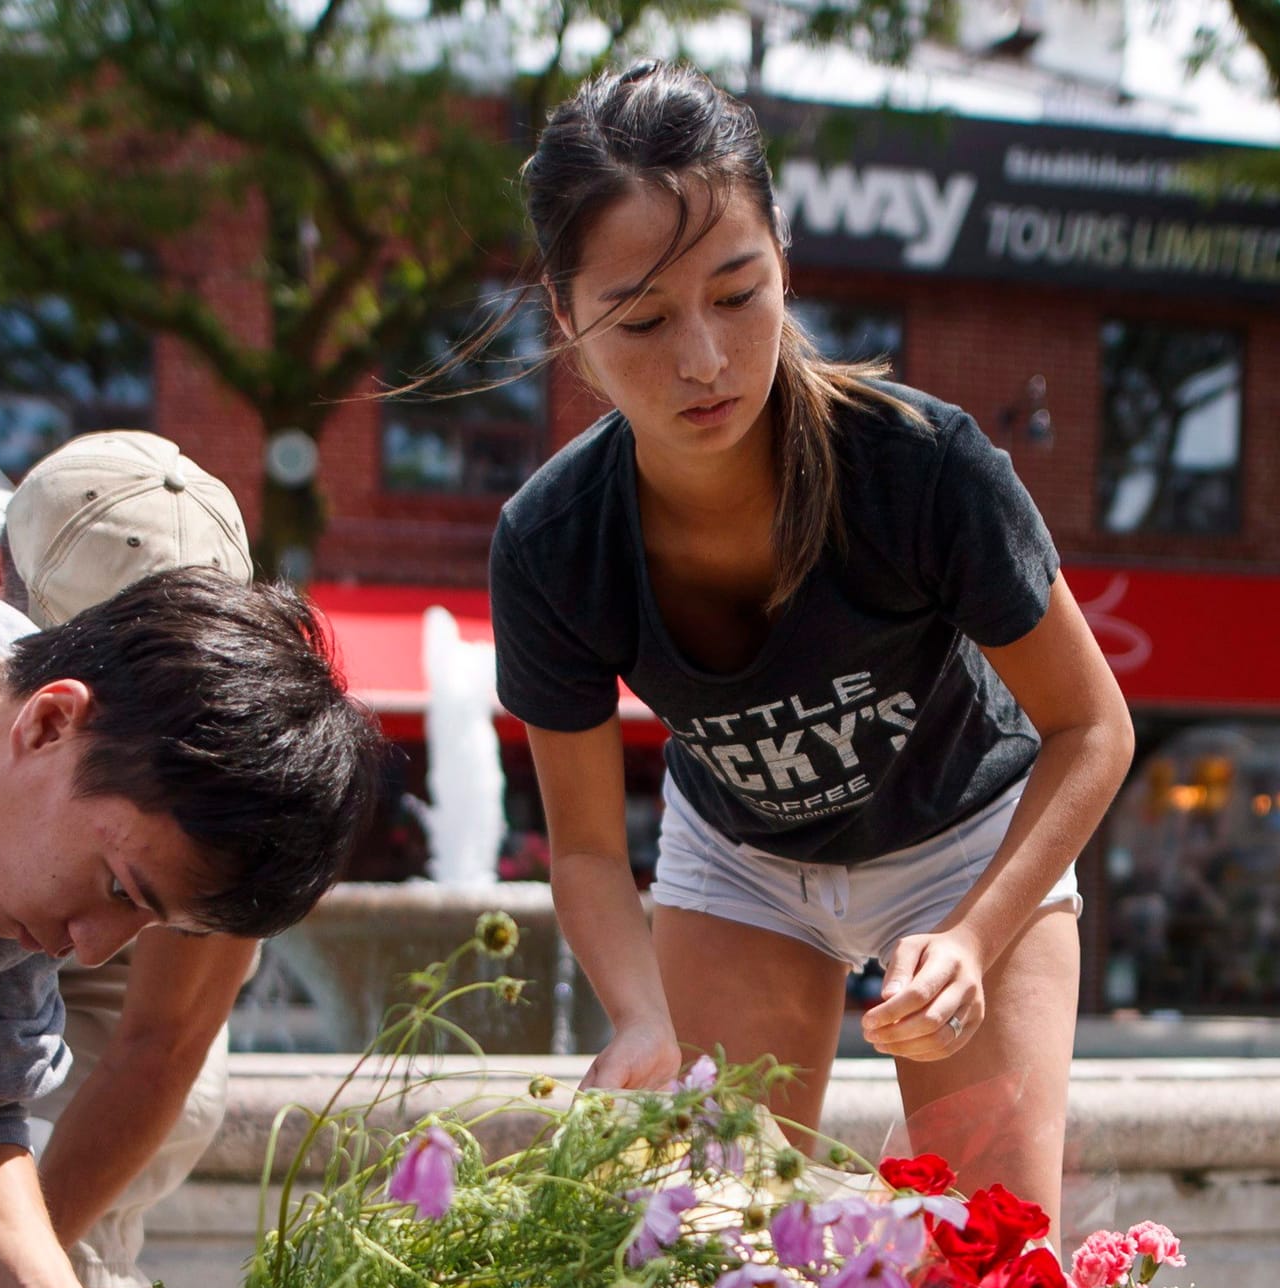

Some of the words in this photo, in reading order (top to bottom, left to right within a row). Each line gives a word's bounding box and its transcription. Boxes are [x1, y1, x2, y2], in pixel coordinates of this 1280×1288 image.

[987, 204, 1126, 268] TOURS
[662, 671, 876, 738] LITTLE
[777, 805, 841, 821] TORONTO
